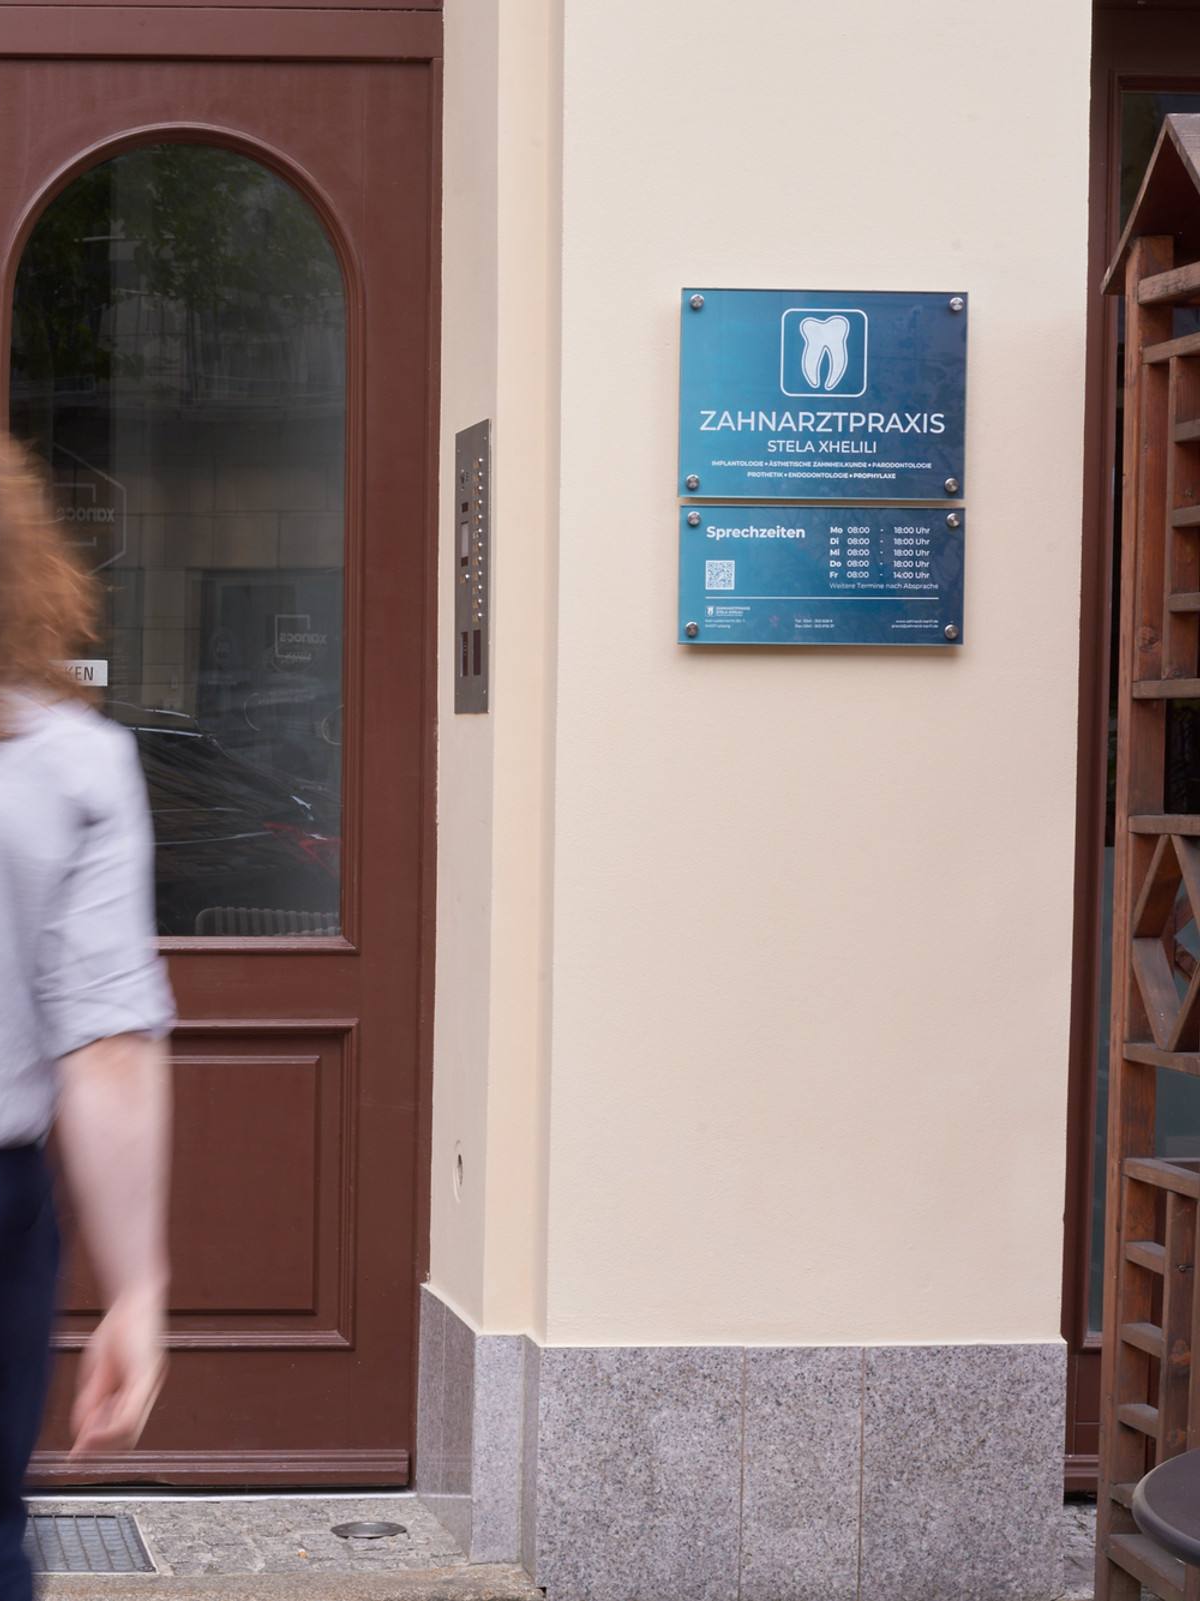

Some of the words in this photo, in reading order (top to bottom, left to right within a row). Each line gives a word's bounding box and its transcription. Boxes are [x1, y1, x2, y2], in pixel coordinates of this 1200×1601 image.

[699, 410, 946, 434] ZAHNARZTPRAXIS
[767, 441, 815, 453] STELA
[818, 441, 877, 453] XHELILI
[706, 525, 805, 540] Sprechzeiten
[829, 526, 843, 534] Mo
[847, 526, 870, 534] 08:00
[893, 538, 914, 546] 18:00
[915, 538, 930, 546] Uhr
[893, 549, 914, 557] 18:00
[915, 549, 930, 557] Uhr
[893, 560, 914, 568] 18:00
[915, 560, 930, 568] Uhr
[829, 571, 838, 579] Fr
[847, 571, 870, 579] 08:00
[893, 571, 914, 579] 14:00
[915, 571, 930, 579] Uhr
